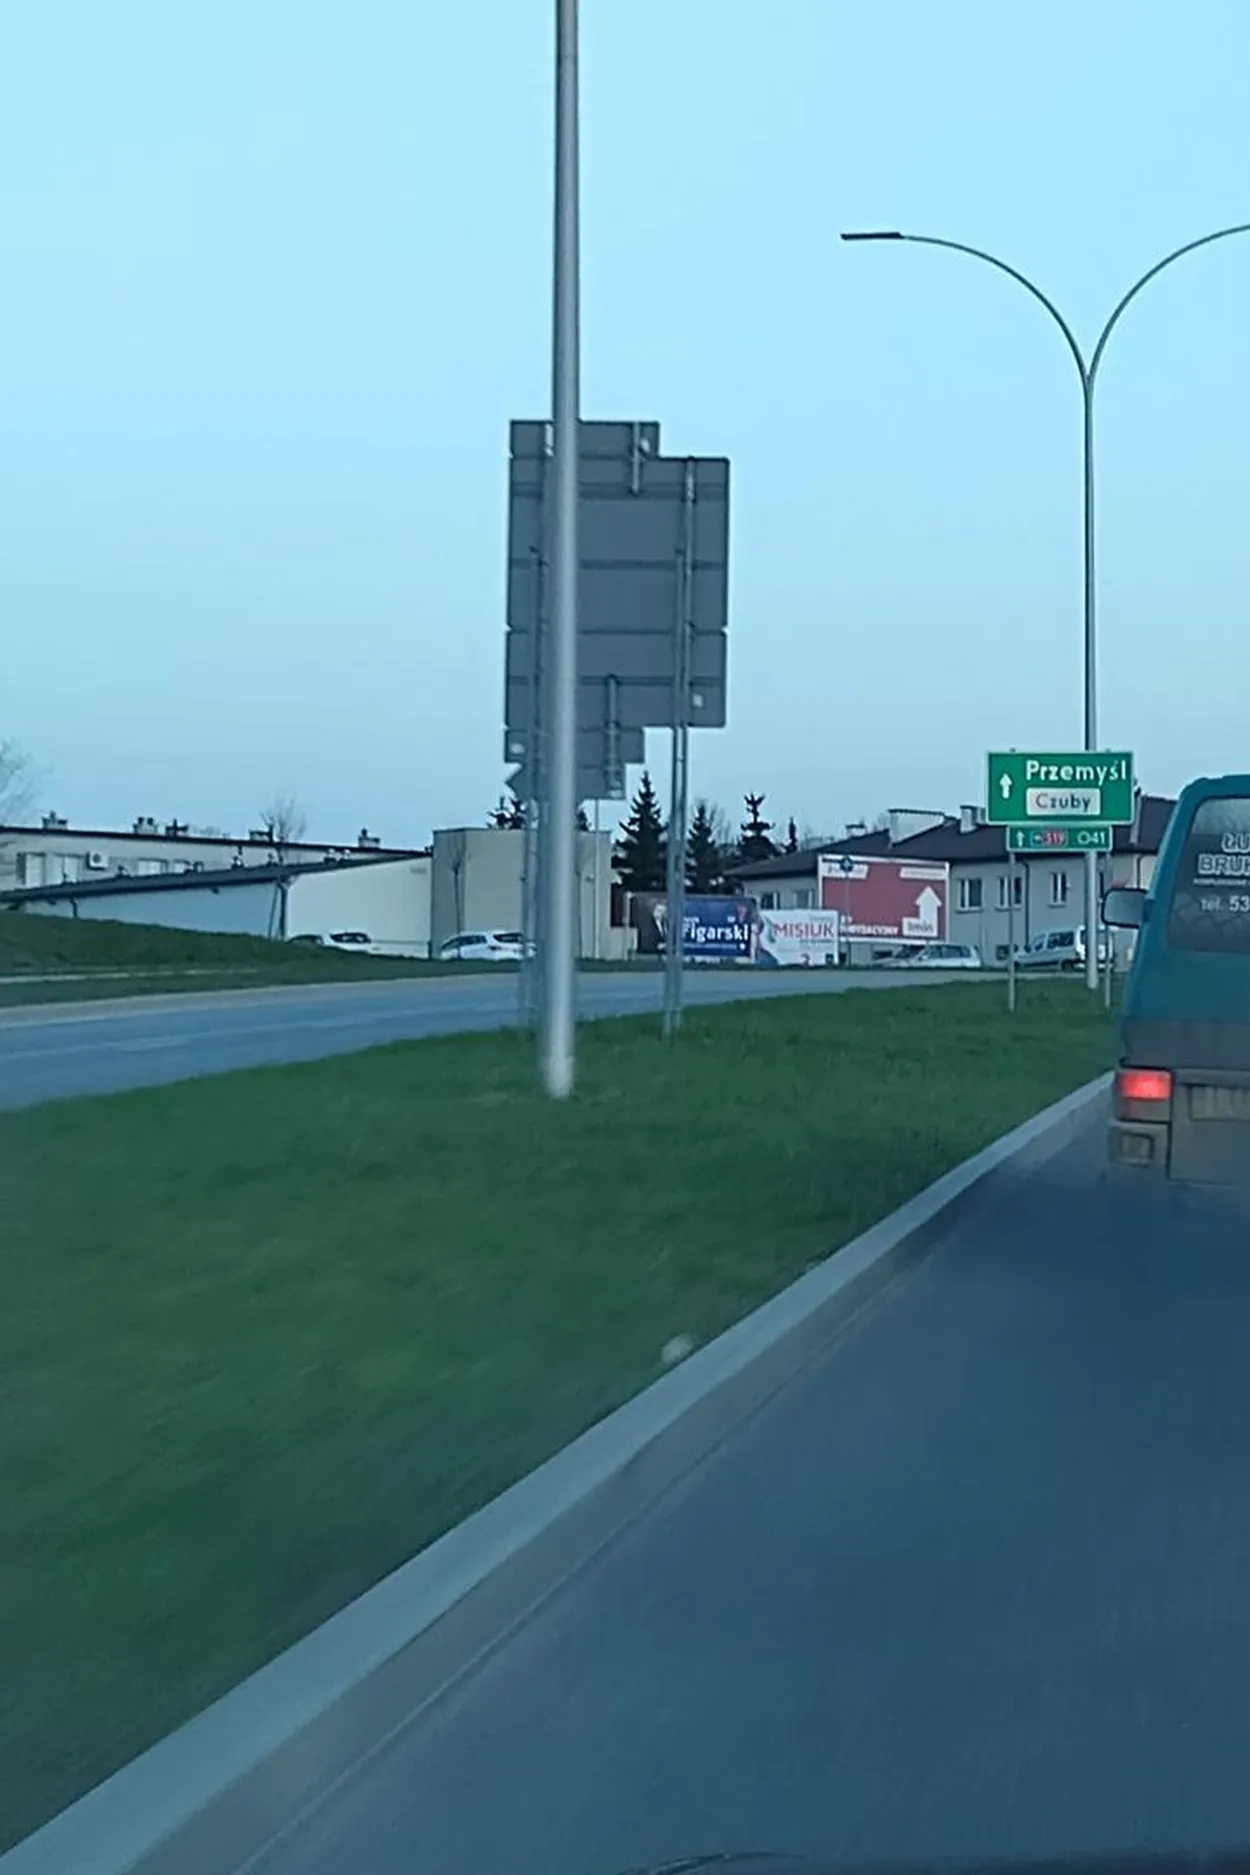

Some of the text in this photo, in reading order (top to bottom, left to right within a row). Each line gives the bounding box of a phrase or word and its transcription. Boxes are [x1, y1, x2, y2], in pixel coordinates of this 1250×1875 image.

[1026, 759, 1127, 786] Przemyśl
[1035, 793, 1091, 812] Czuby
[682, 922, 749, 943] Figarski
[774, 923, 834, 938] MISIUK
